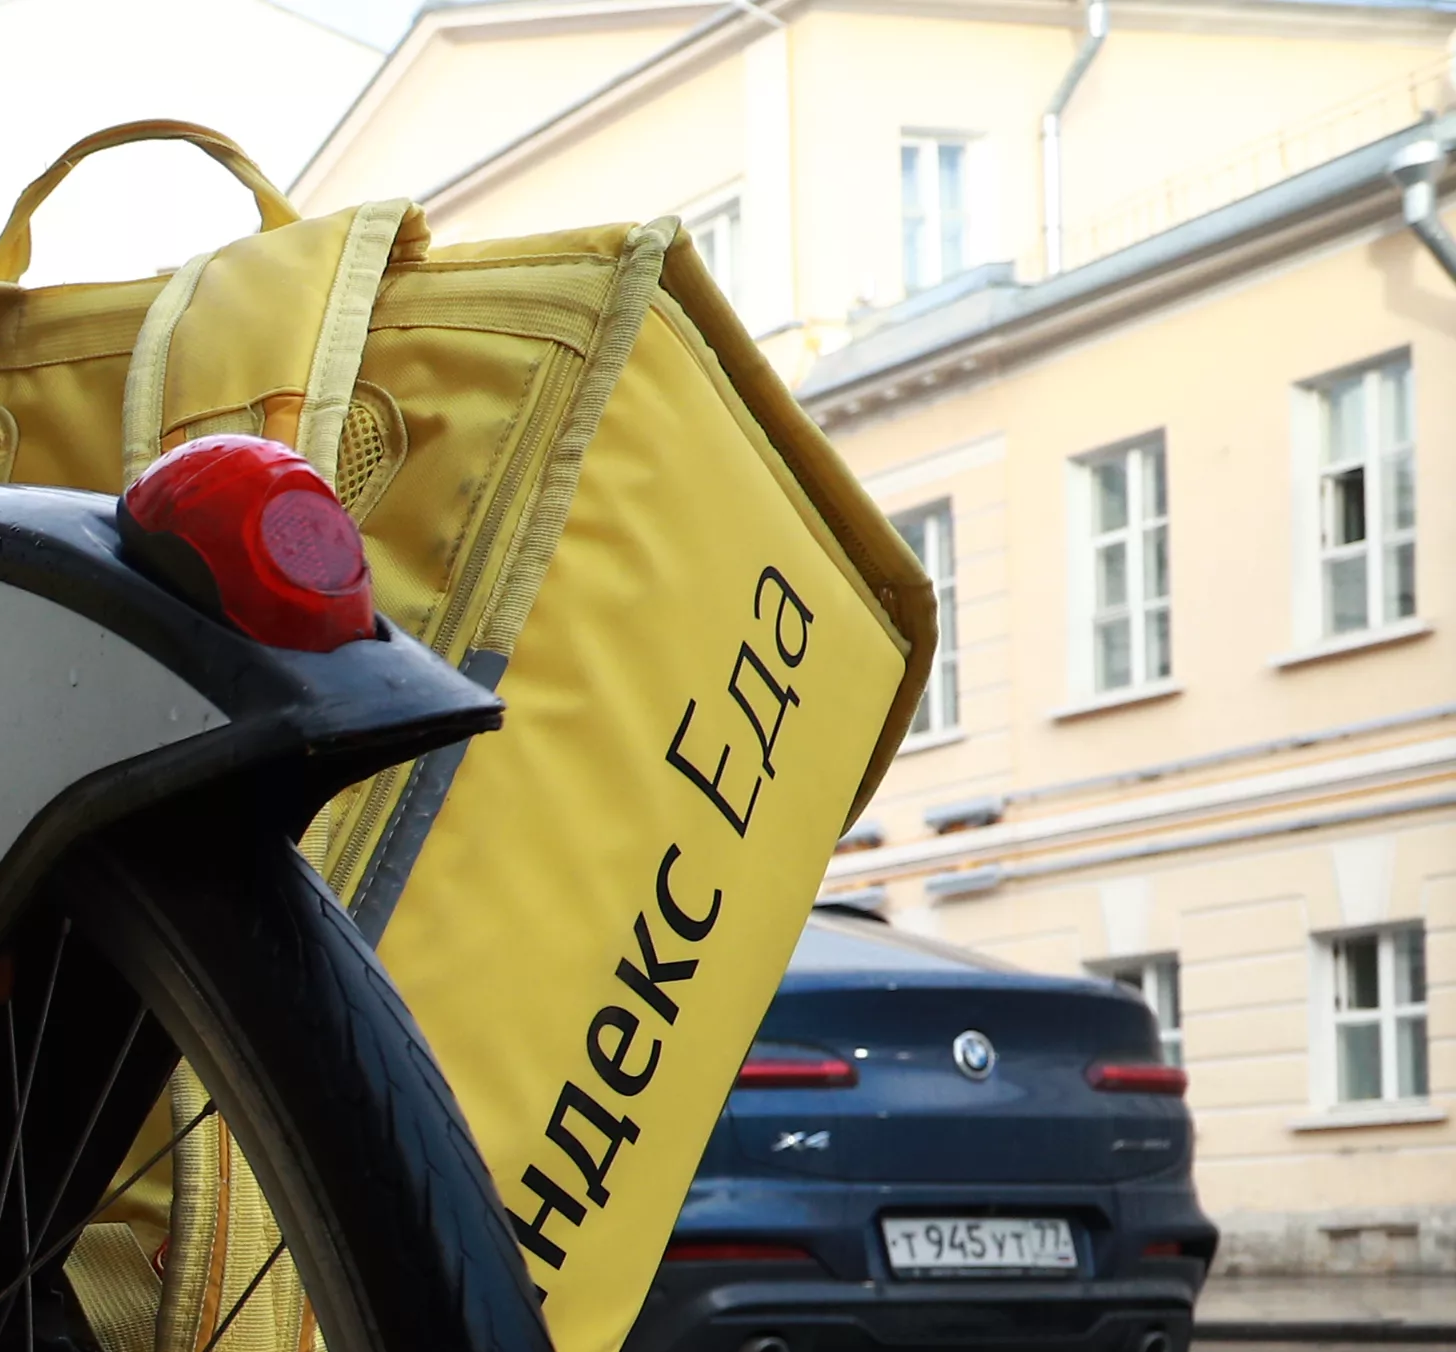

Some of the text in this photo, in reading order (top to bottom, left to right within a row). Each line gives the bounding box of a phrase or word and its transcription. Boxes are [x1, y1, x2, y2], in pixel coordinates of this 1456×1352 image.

[504, 565, 815, 1307] ндекс Еда
[771, 1131, 830, 1152] X4
